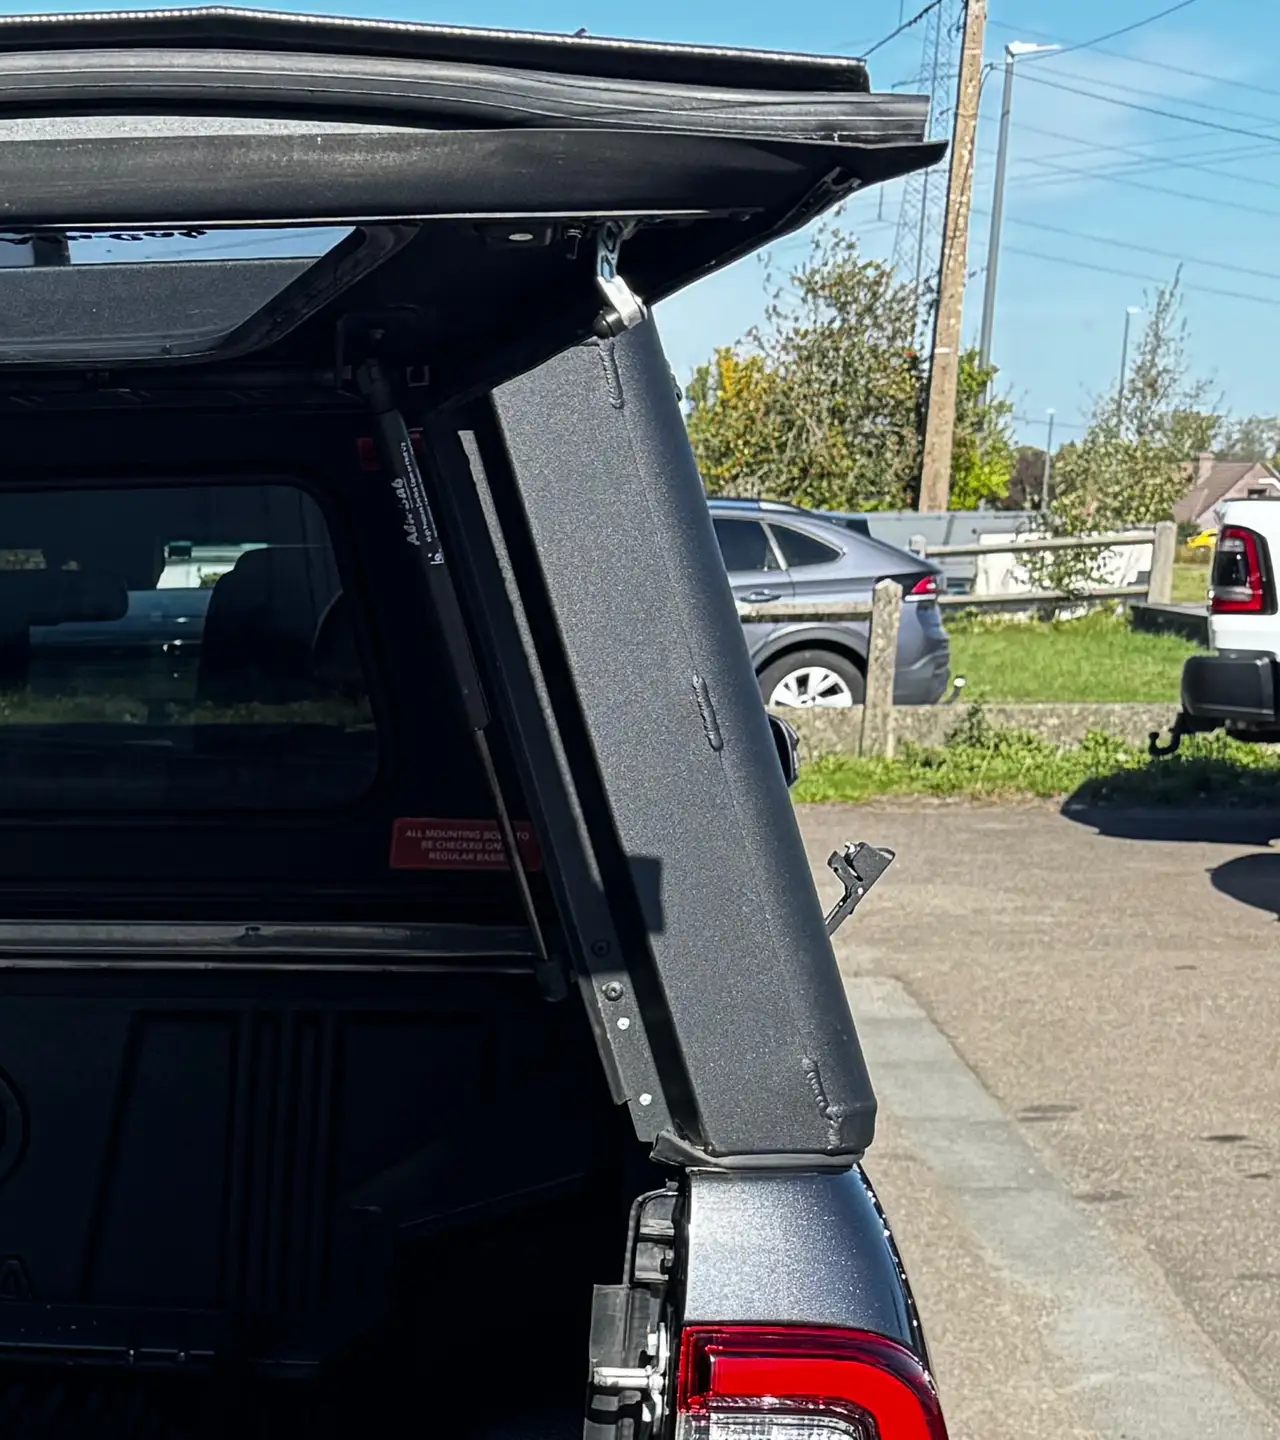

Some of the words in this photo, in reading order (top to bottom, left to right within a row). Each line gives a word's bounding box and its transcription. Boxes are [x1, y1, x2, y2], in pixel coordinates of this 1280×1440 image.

[404, 828, 422, 838] ALL
[425, 829, 480, 840] MOUNTING
[421, 840, 433, 850] BE
[436, 840, 483, 851] CHECKED
[428, 851, 475, 861] REGULAR
